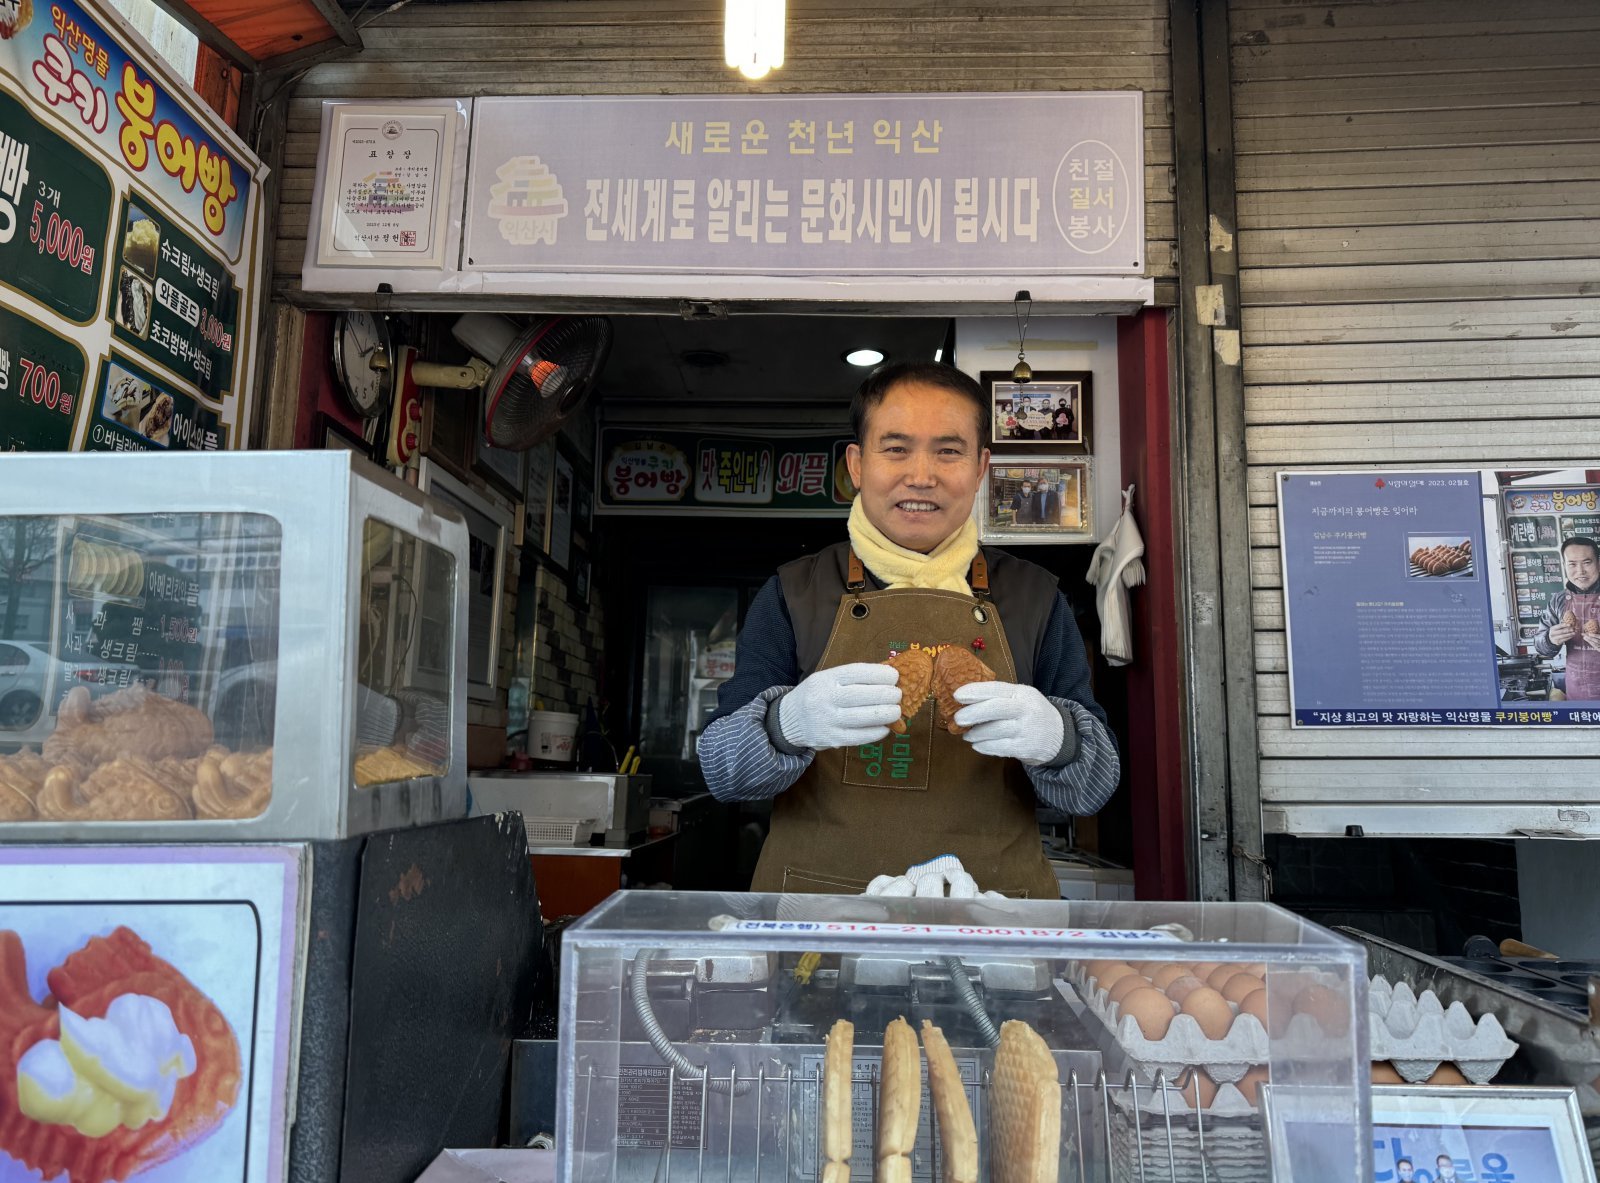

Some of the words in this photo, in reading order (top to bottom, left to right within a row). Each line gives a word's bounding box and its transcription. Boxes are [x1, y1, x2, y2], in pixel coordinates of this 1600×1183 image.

[51, 4, 109, 79] 익산명물
[32, 33, 108, 133] 쿠키
[114, 62, 237, 236] 붕어빵
[665, 119, 769, 155] 새로운
[788, 119, 854, 155] 천년
[873, 119, 943, 154] 익산
[1068, 159, 1115, 181] 친절
[38, 180, 60, 208] 3개
[584, 178, 695, 242] 전세계로
[707, 179, 788, 243] 알리는
[800, 177, 941, 243] 문화시민이
[954, 177, 1040, 243] 됩시다
[1068, 186, 1115, 210] 질서
[30, 200, 95, 275] 5,000원
[1068, 216, 1116, 240] 봉사
[161, 238, 220, 301] 슈크림+생크림
[159, 282, 198, 323] 와플골드
[150, 320, 213, 381] 초코범벅+생크림
[20, 357, 73, 415] 700원
[613, 465, 686, 496] 붕어빵
[701, 447, 717, 492] 맛
[776, 452, 829, 497] 와플
[1311, 506, 1353, 516] 지금까지의
[1355, 506, 1391, 516] 붕어빵은
[1552, 491, 1598, 511] 붕어빵
[101, 640, 138, 662] 생크림
[98, 667, 132, 688] 생크림
[1345, 712, 1378, 723] 최고의
[1382, 712, 1394, 723] 맛
[1397, 712, 1442, 723] 자랑하는
[1445, 711, 1492, 723] 익산명물
[826, 924, 1087, 937] 514-21-0001872
